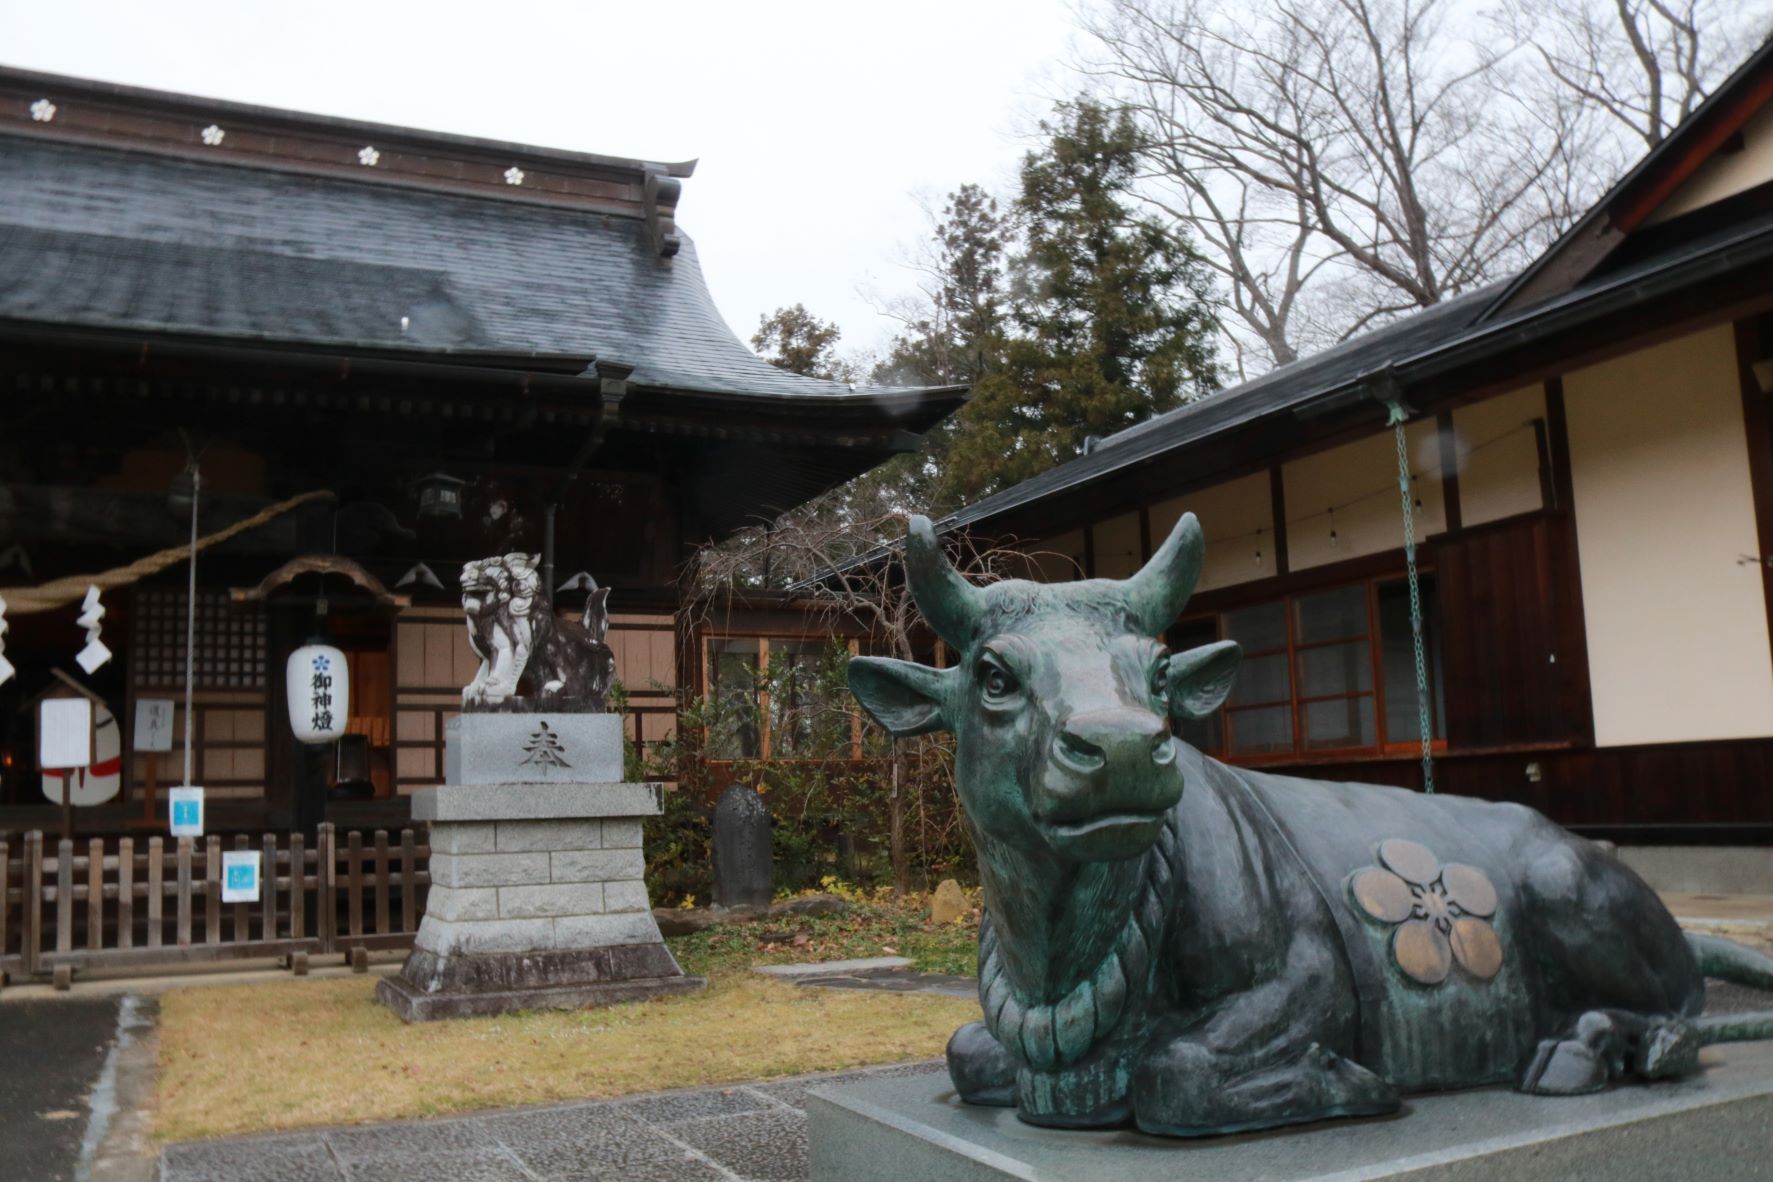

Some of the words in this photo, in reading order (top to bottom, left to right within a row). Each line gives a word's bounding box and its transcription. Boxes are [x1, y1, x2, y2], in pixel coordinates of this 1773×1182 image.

[310, 672, 333, 731] 御神燈
[518, 720, 573, 776] 奉
